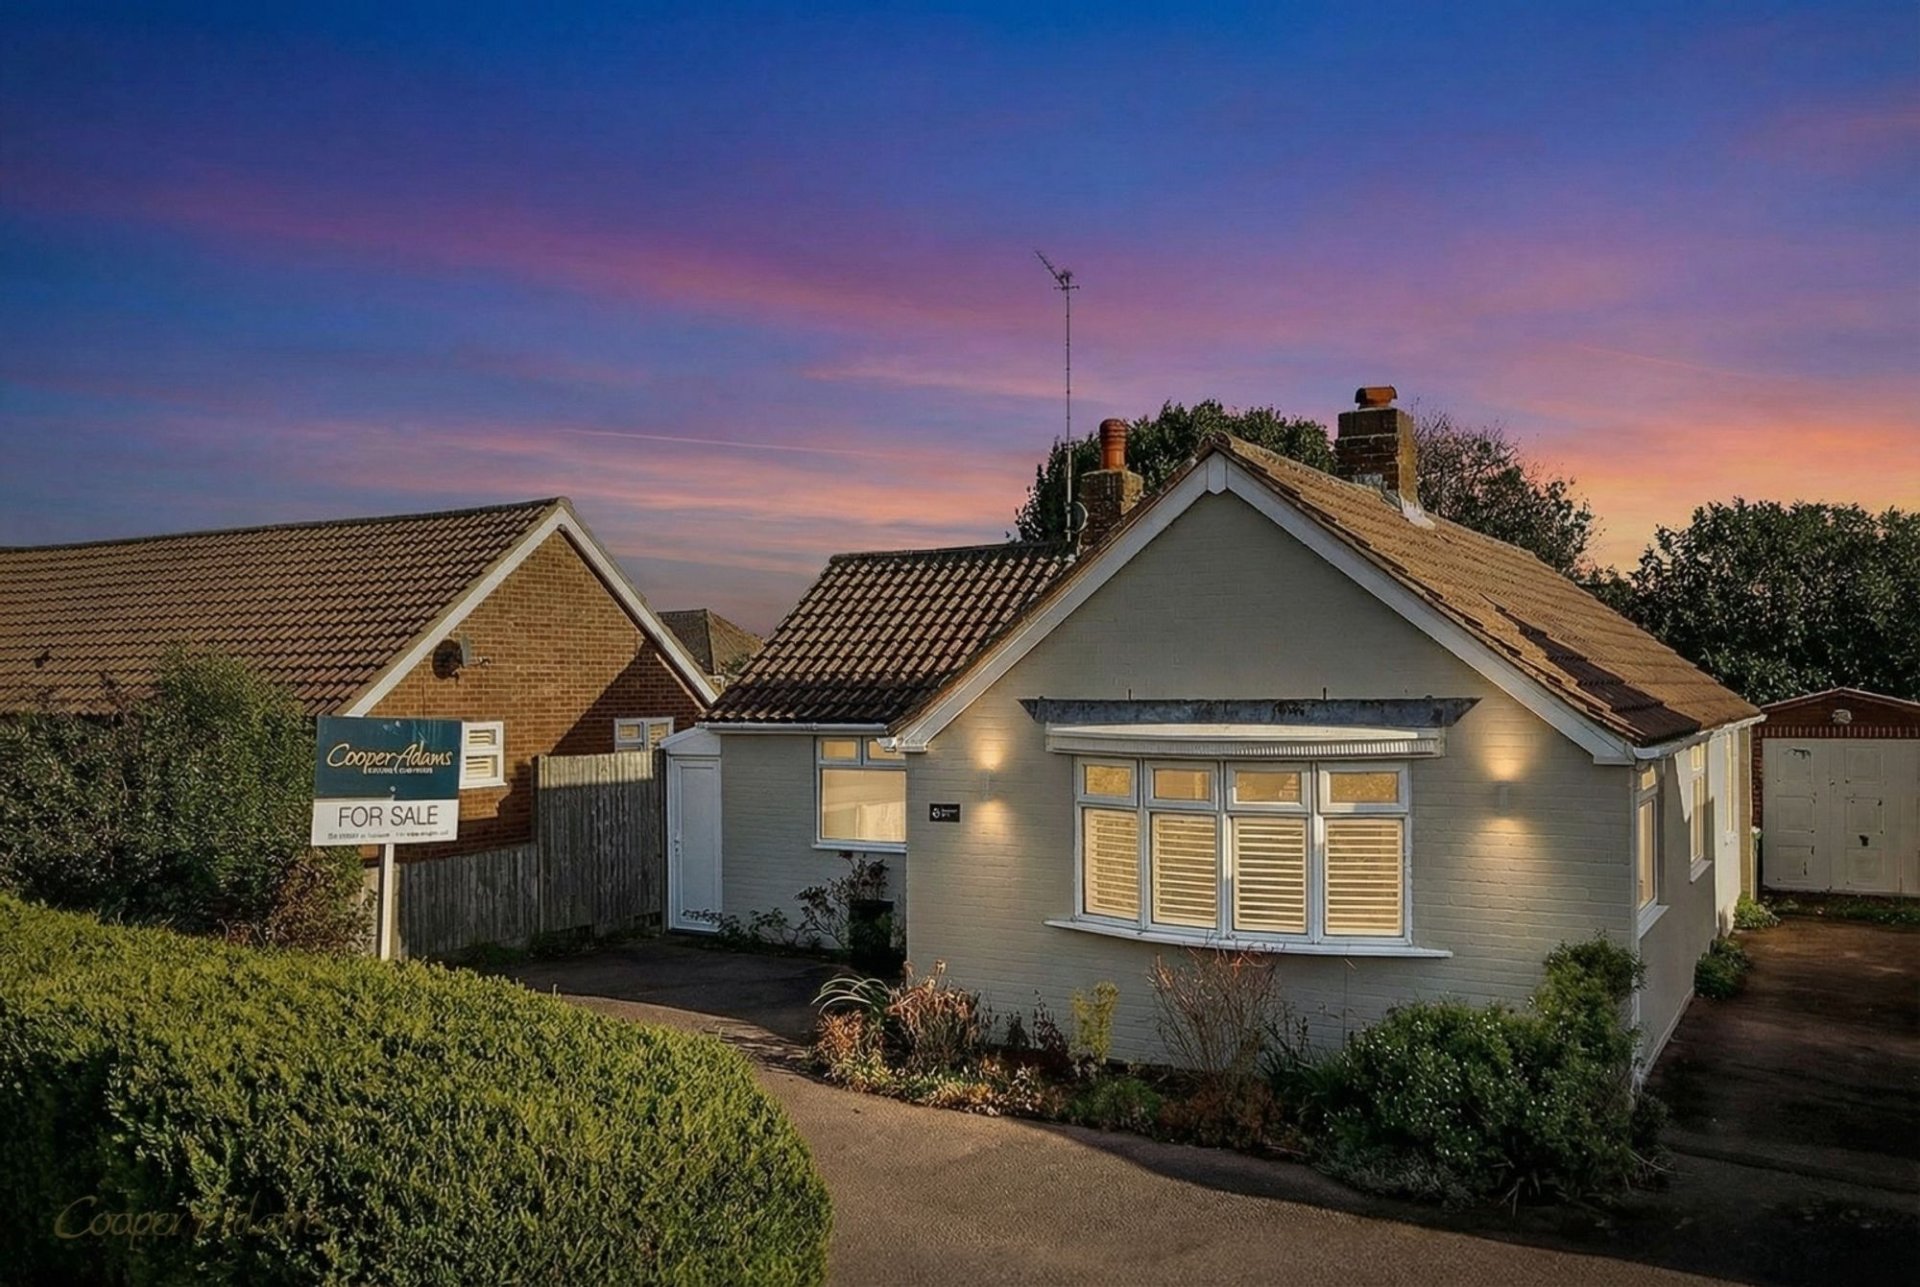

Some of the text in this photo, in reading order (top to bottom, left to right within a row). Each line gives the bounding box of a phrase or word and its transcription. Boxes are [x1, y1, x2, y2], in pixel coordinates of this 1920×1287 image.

[327, 740, 453, 774] Cooper Adams
[338, 805, 438, 827] FOR SALE
